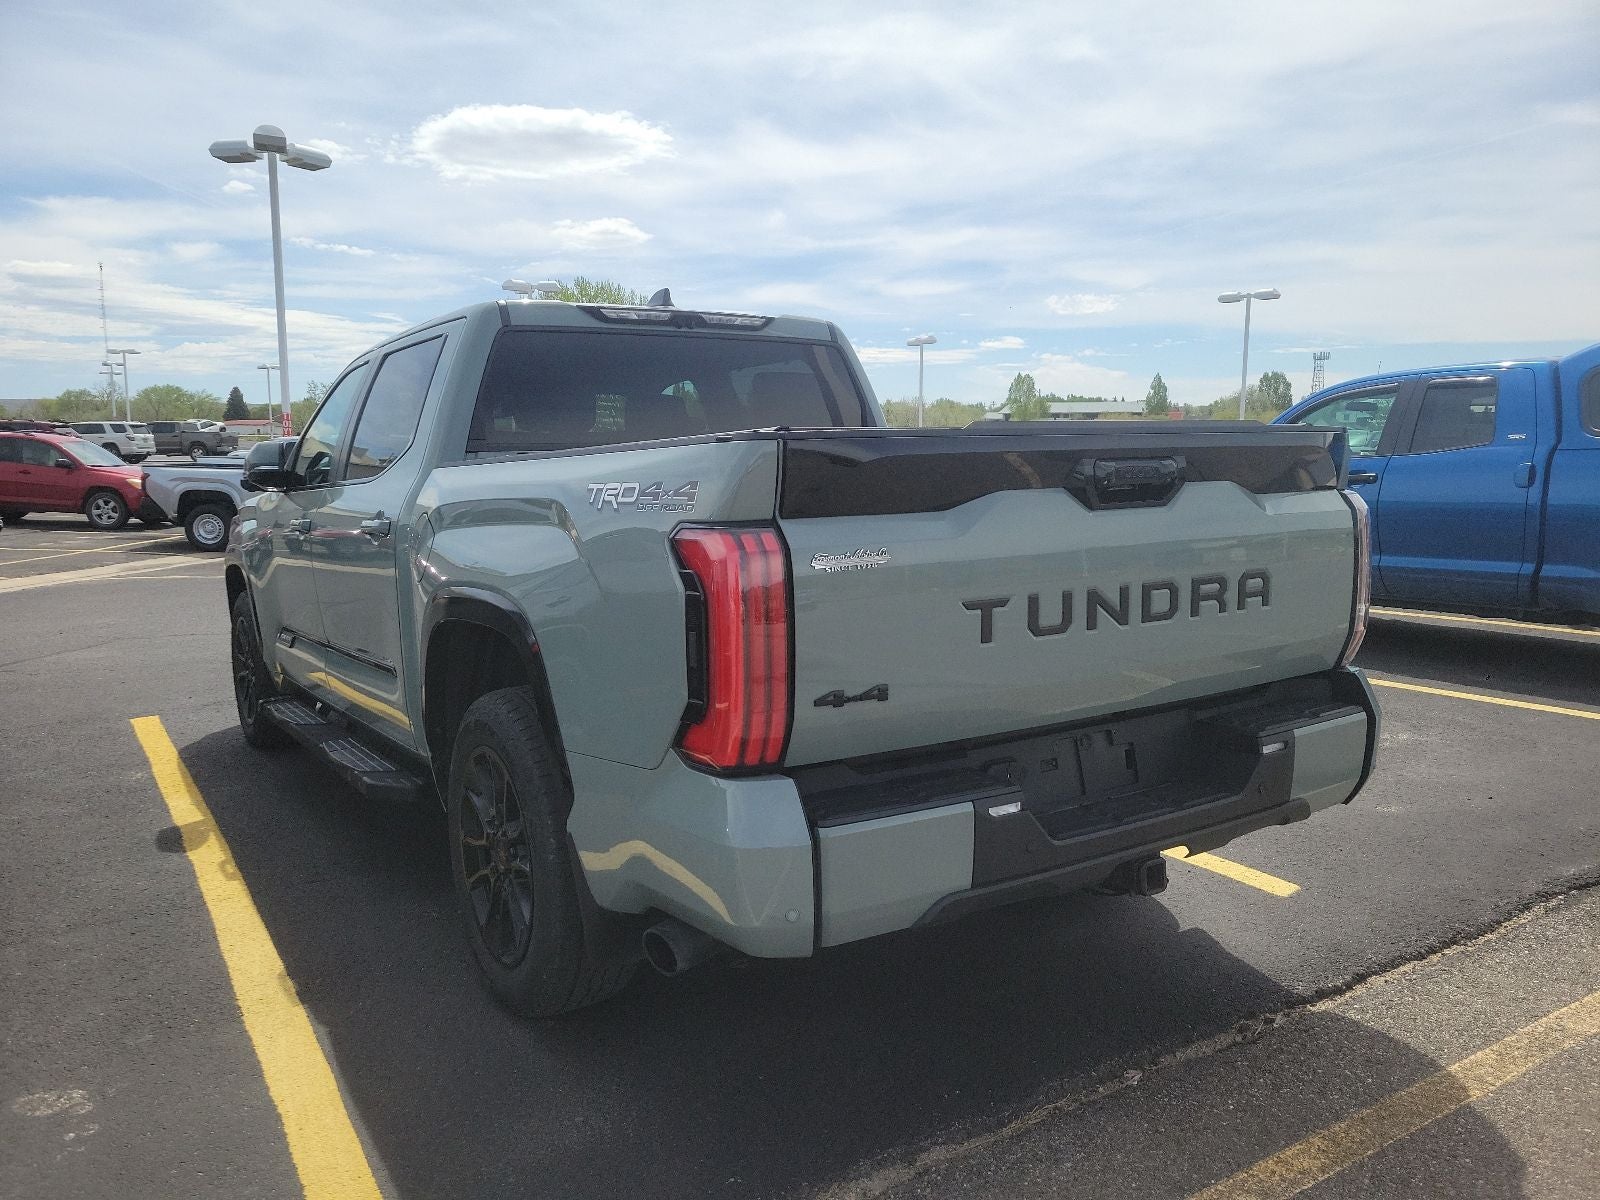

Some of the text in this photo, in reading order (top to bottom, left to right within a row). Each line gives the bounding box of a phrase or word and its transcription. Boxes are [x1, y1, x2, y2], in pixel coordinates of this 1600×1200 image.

[587, 481, 640, 510] TRD
[636, 502, 696, 514] OFF ROAD
[826, 564, 852, 573] SINCE
[960, 568, 1271, 645] TUNDRA
